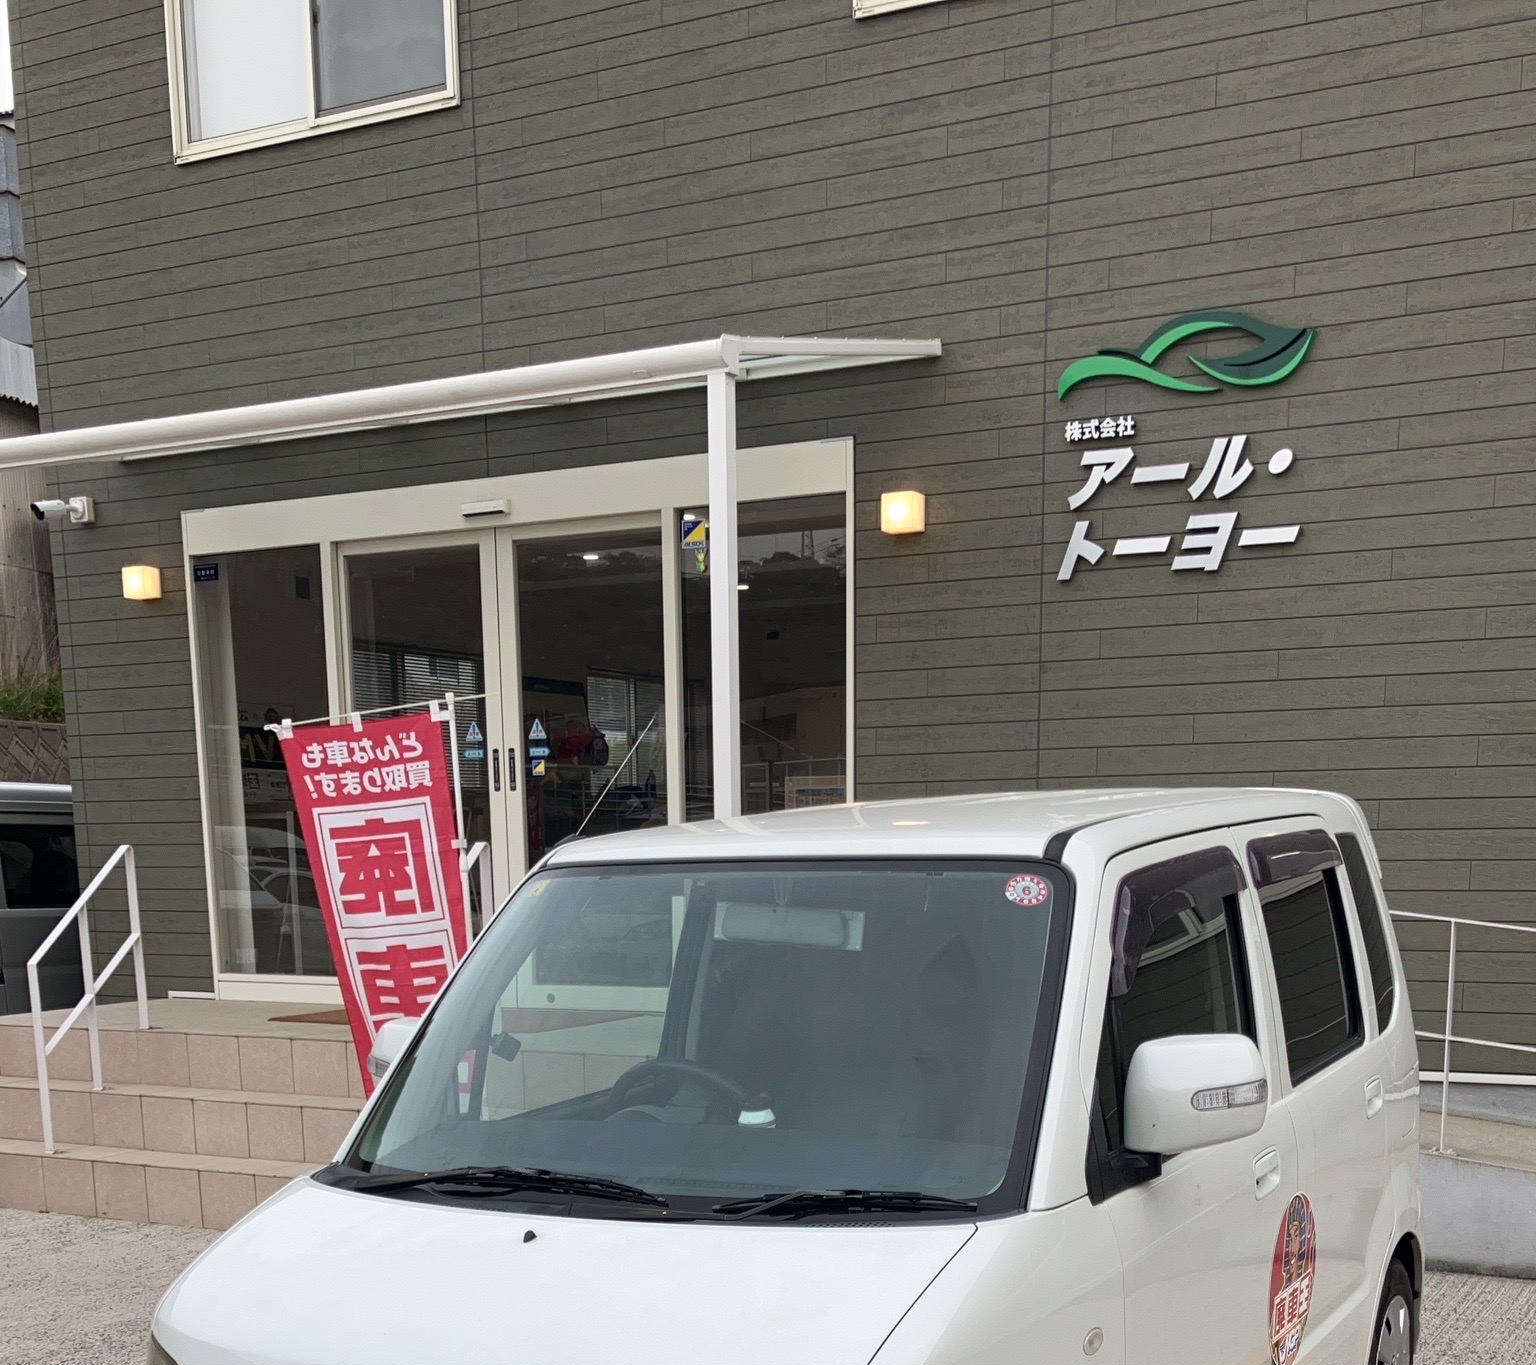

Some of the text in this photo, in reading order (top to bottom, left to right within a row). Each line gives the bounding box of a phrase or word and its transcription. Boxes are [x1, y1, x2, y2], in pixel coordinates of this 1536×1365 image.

[1064, 415, 1136, 442] 株式会社
[1067, 434, 1293, 511] アール・
[1057, 511, 1301, 581] トーヨー
